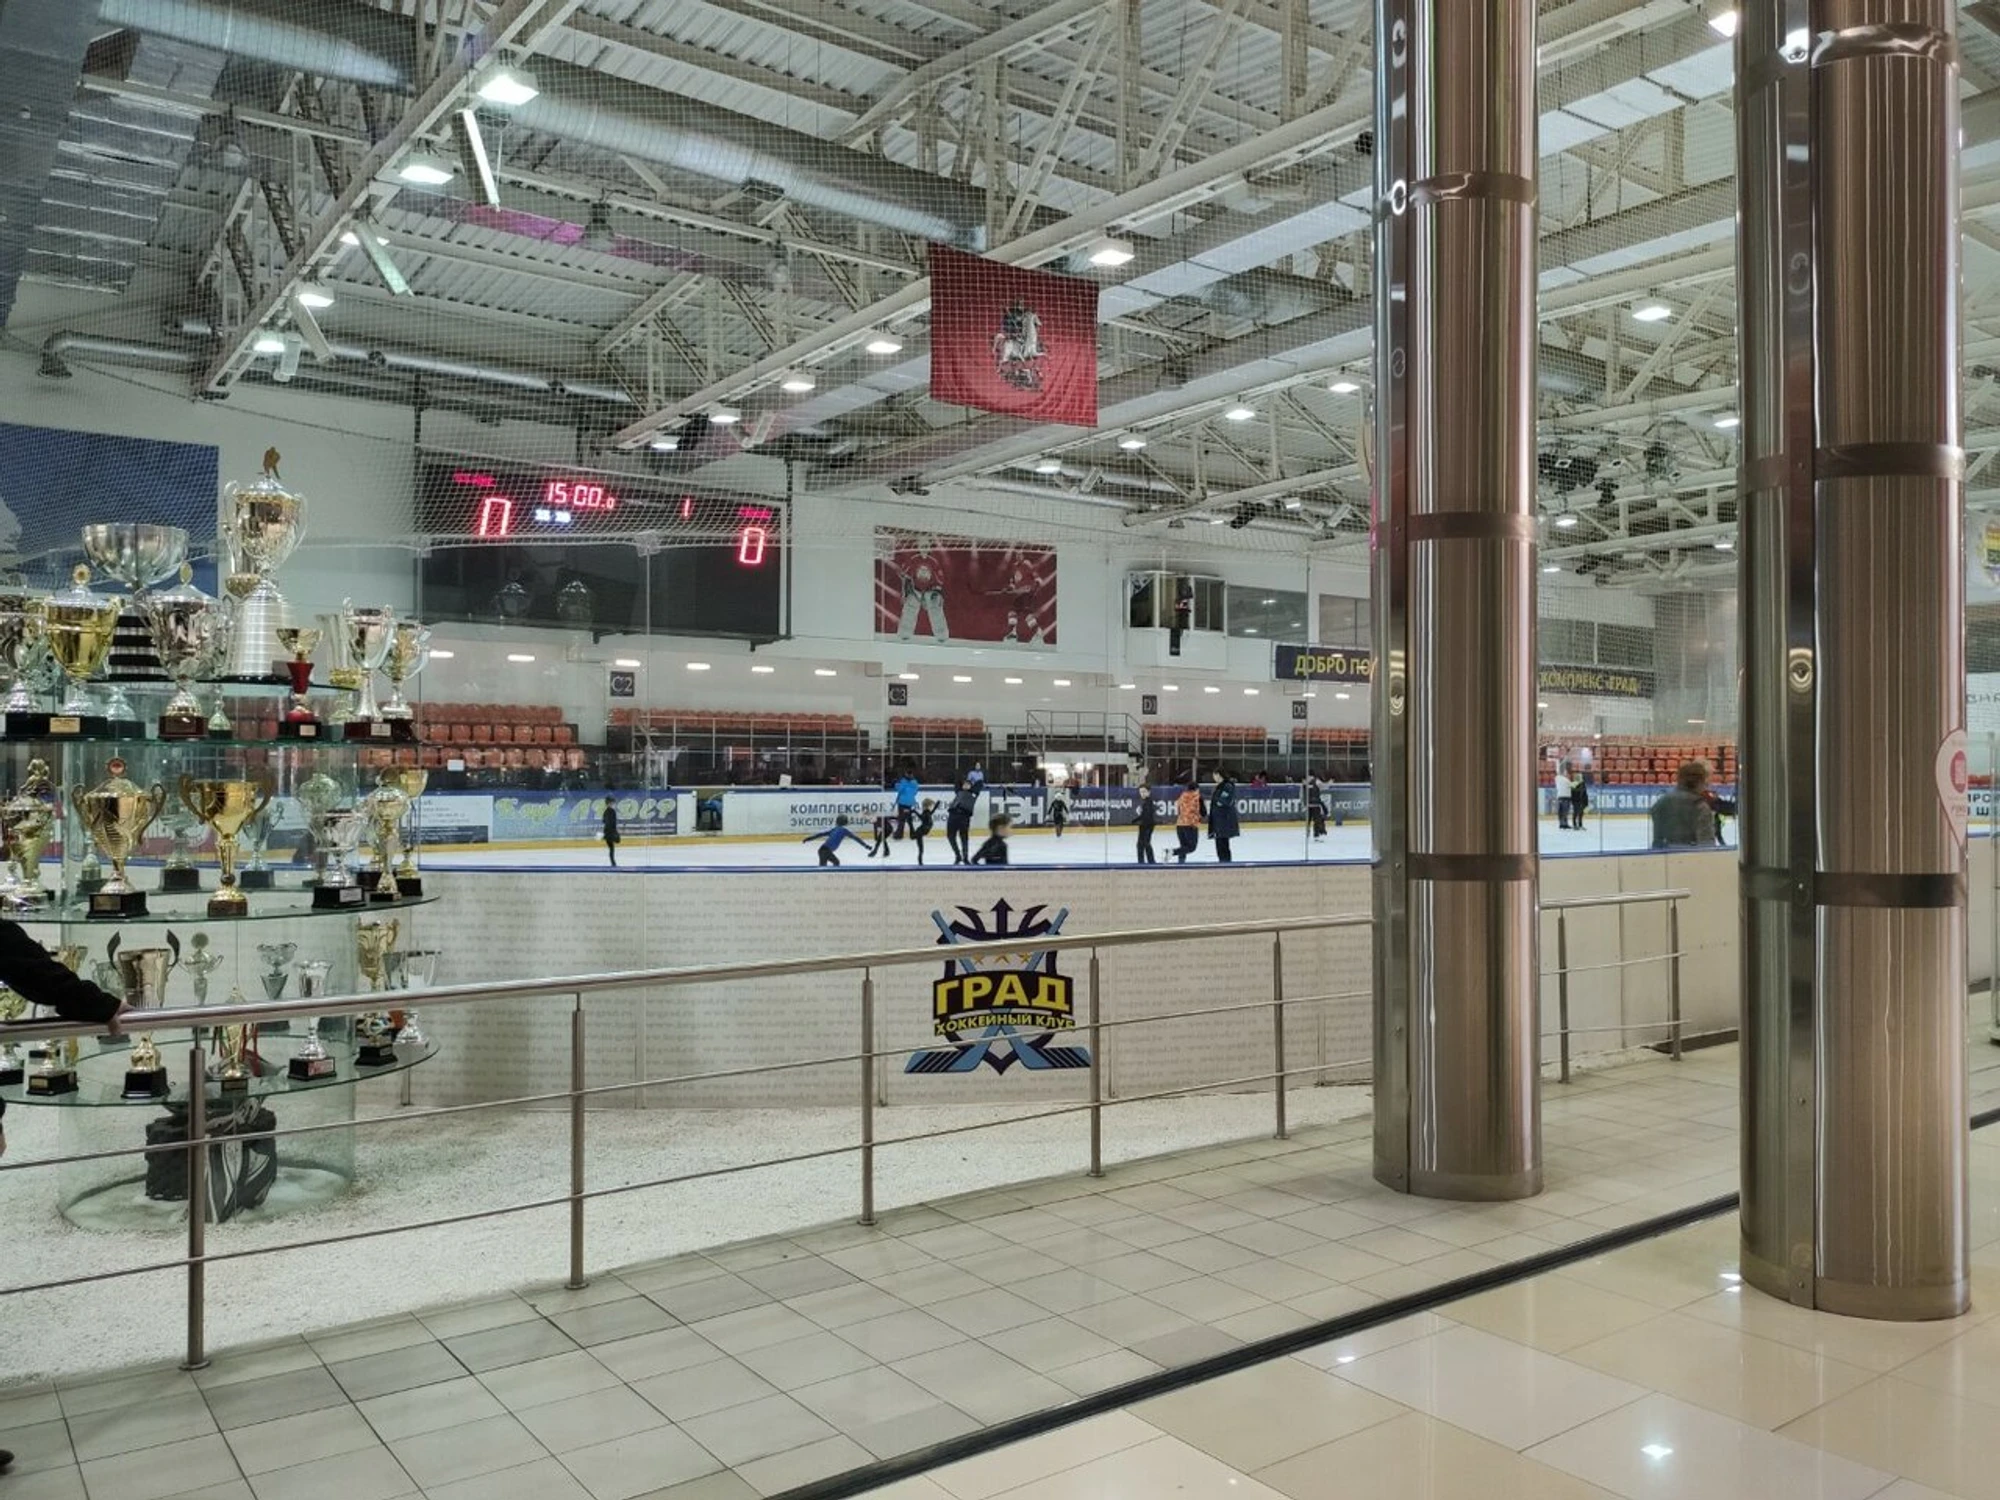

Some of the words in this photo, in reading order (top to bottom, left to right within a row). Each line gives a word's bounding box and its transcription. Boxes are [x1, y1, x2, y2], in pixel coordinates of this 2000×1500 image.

[740, 527, 765, 564] 0
[1294, 654, 1346, 676] ДОБРО
[936, 974, 1070, 1016] ГРАД
